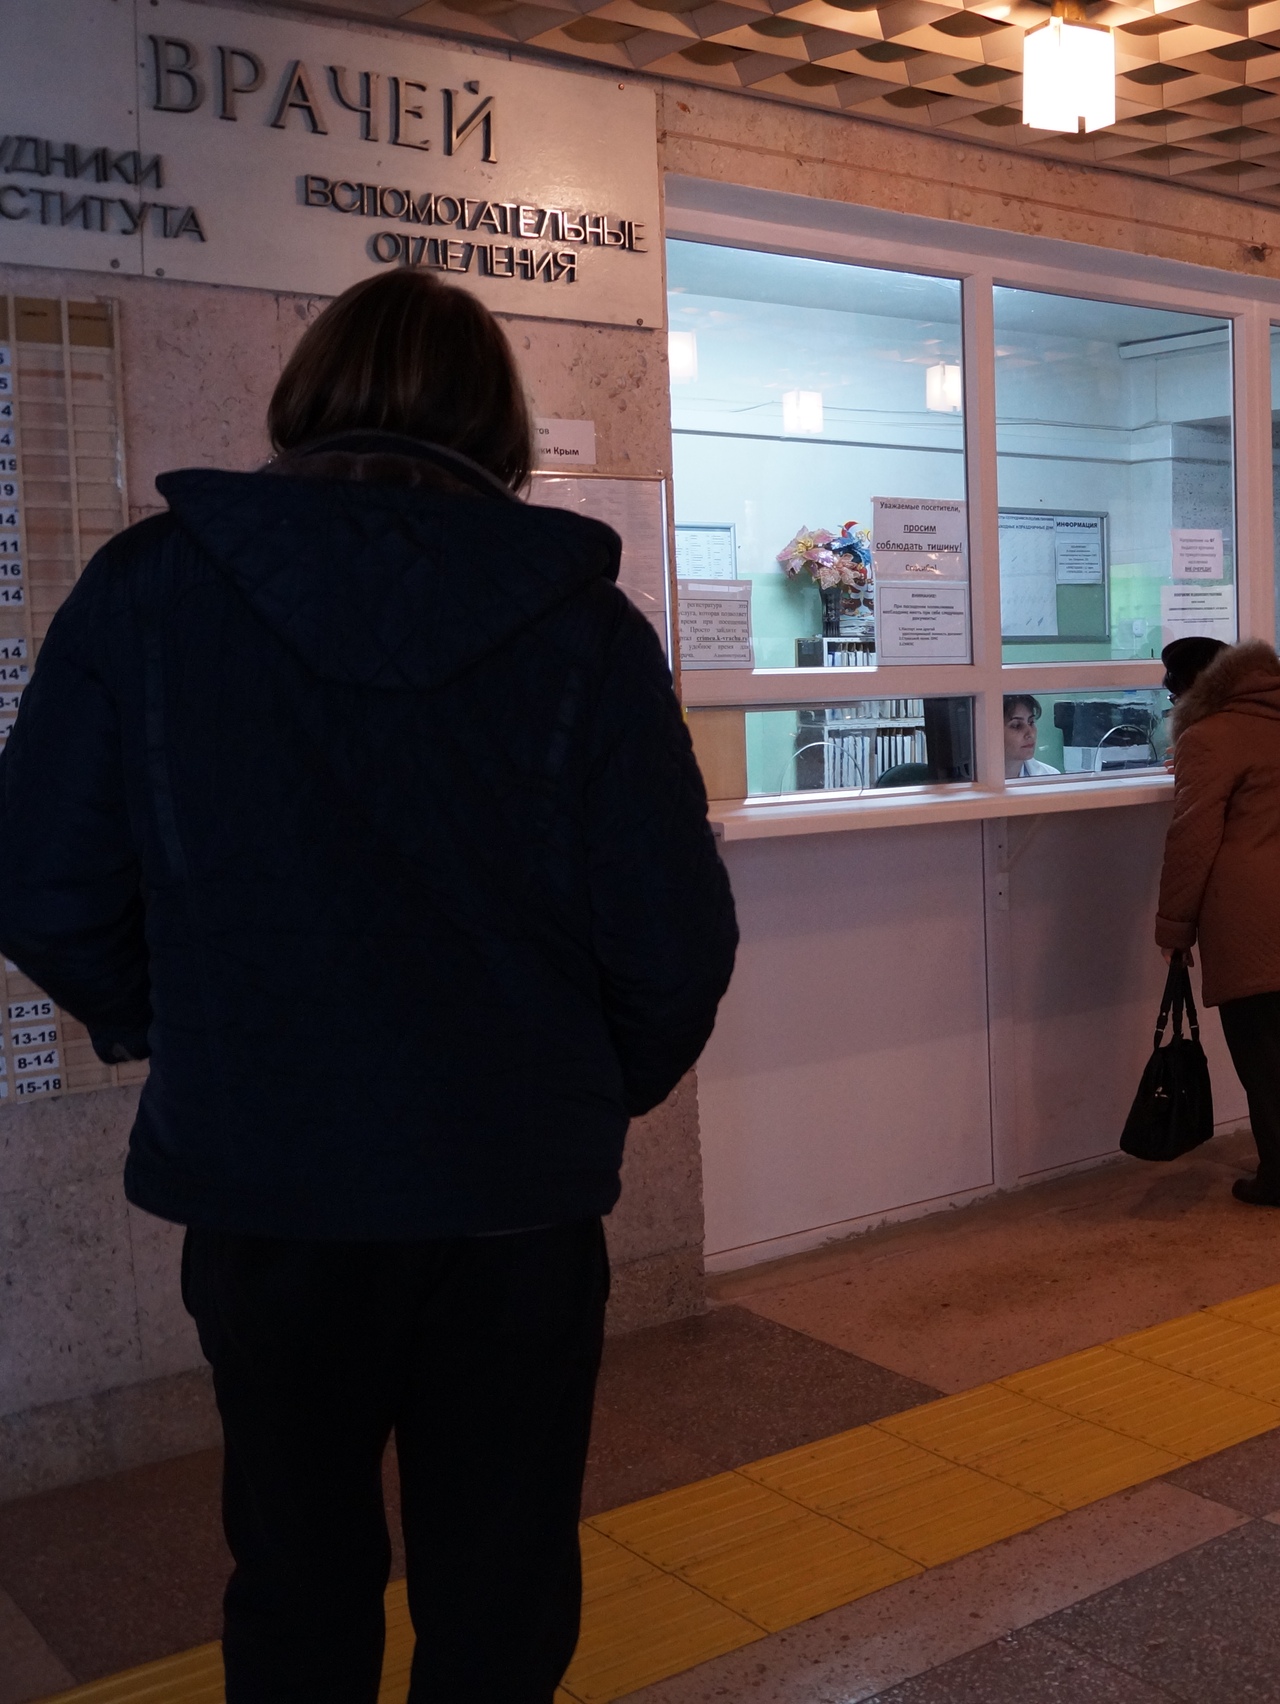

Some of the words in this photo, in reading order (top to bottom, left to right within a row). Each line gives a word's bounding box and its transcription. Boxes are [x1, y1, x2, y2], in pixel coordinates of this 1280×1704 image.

[148, 33, 498, 164] ВРАЧЕЙ
[0, 185, 206, 243] СТИТУТА
[303, 174, 648, 253] ВСПОМОГАТЕЛЬНЫЕ
[370, 231, 578, 283] ОТДЕЛЕНИЯ
[553, 446, 580, 457] Крым
[880, 501, 920, 510] Уважаемые
[921, 504, 961, 513] посетители,
[903, 524, 937, 534] просим
[1056, 521, 1098, 529] ИНФОРМАЦИЯ
[876, 540, 923, 551] соблюдать
[927, 542, 963, 553] тишину!
[8, 1003, 51, 1019] 12-15
[12, 1030, 57, 1046] 13-19
[17, 1079, 61, 1095] 15-18
